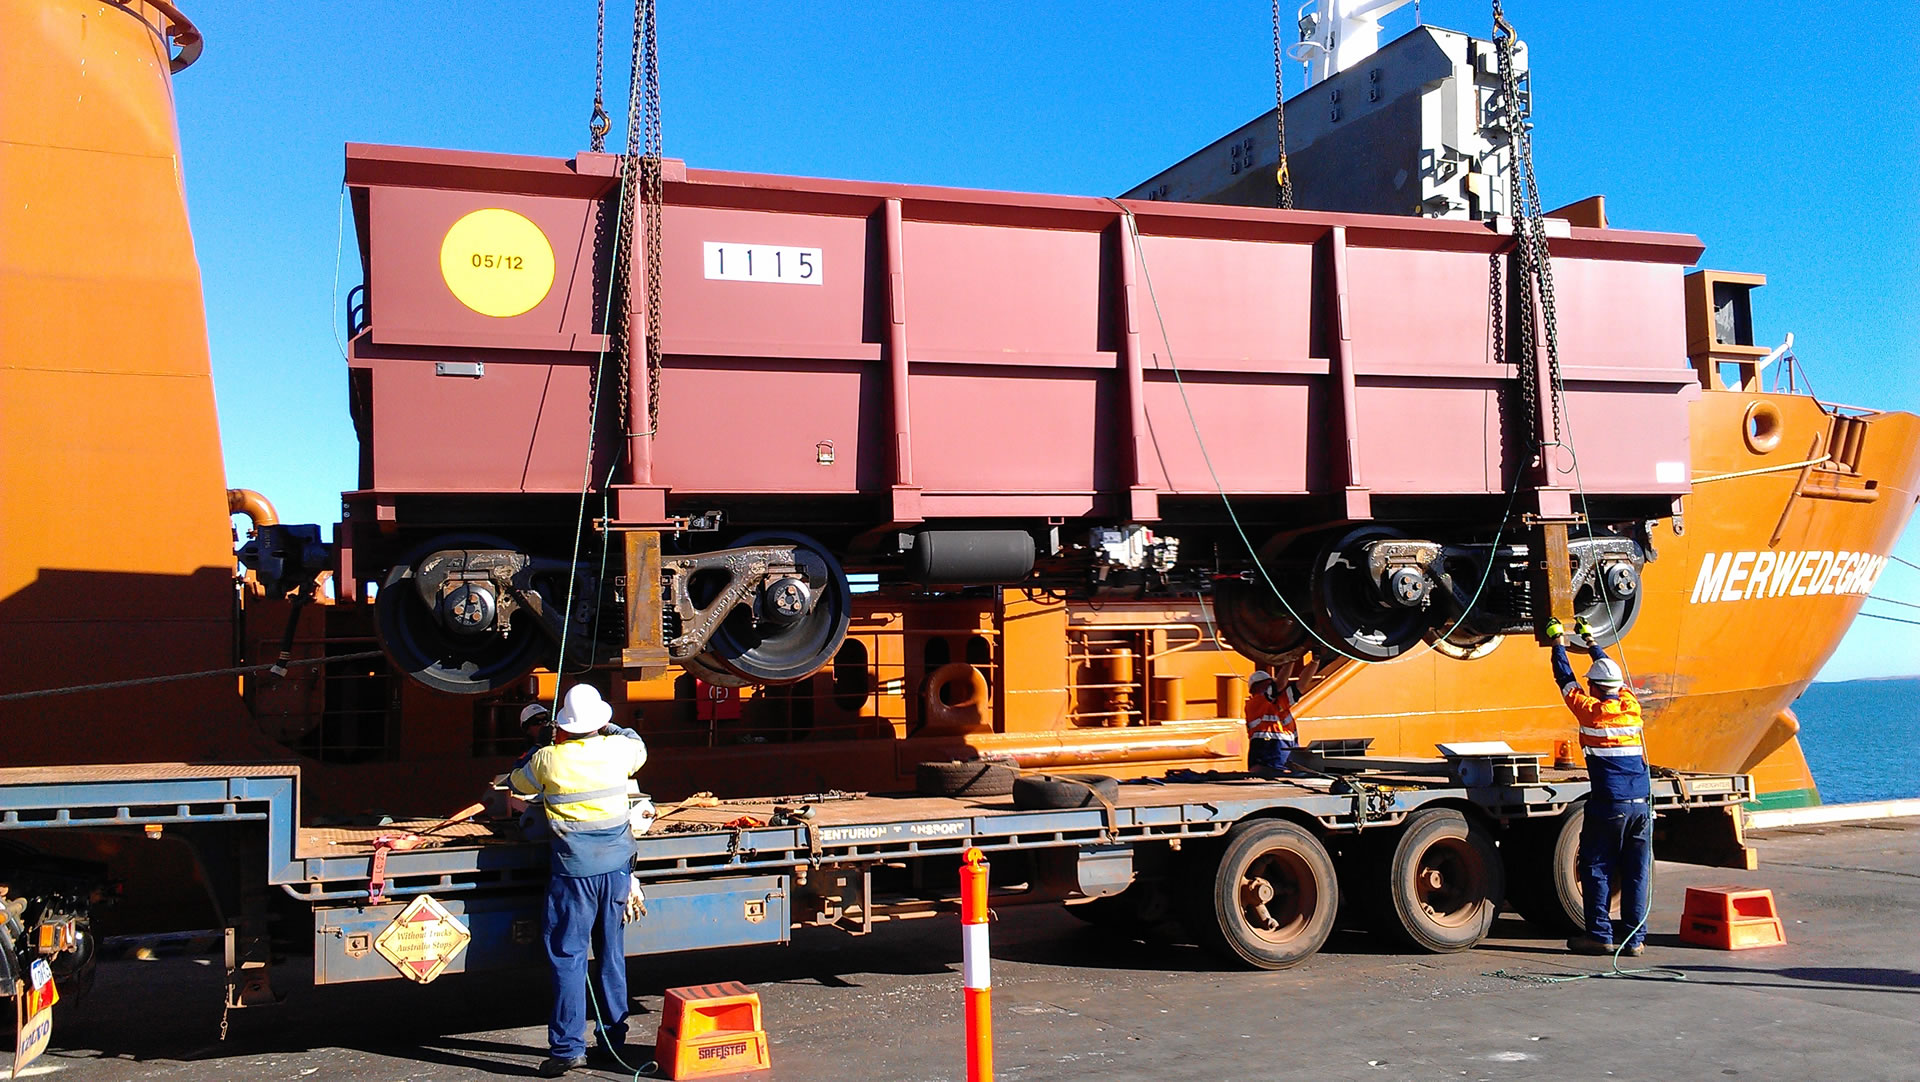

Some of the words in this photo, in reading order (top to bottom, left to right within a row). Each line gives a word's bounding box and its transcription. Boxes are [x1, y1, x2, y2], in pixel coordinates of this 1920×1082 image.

[472, 253, 523, 270] 05/12
[718, 247, 813, 279] 1115
[819, 826, 887, 841] CENTURION
[893, 823, 965, 835] TANSPORT
[396, 943, 430, 953] Australia
[432, 941, 453, 951] Stops
